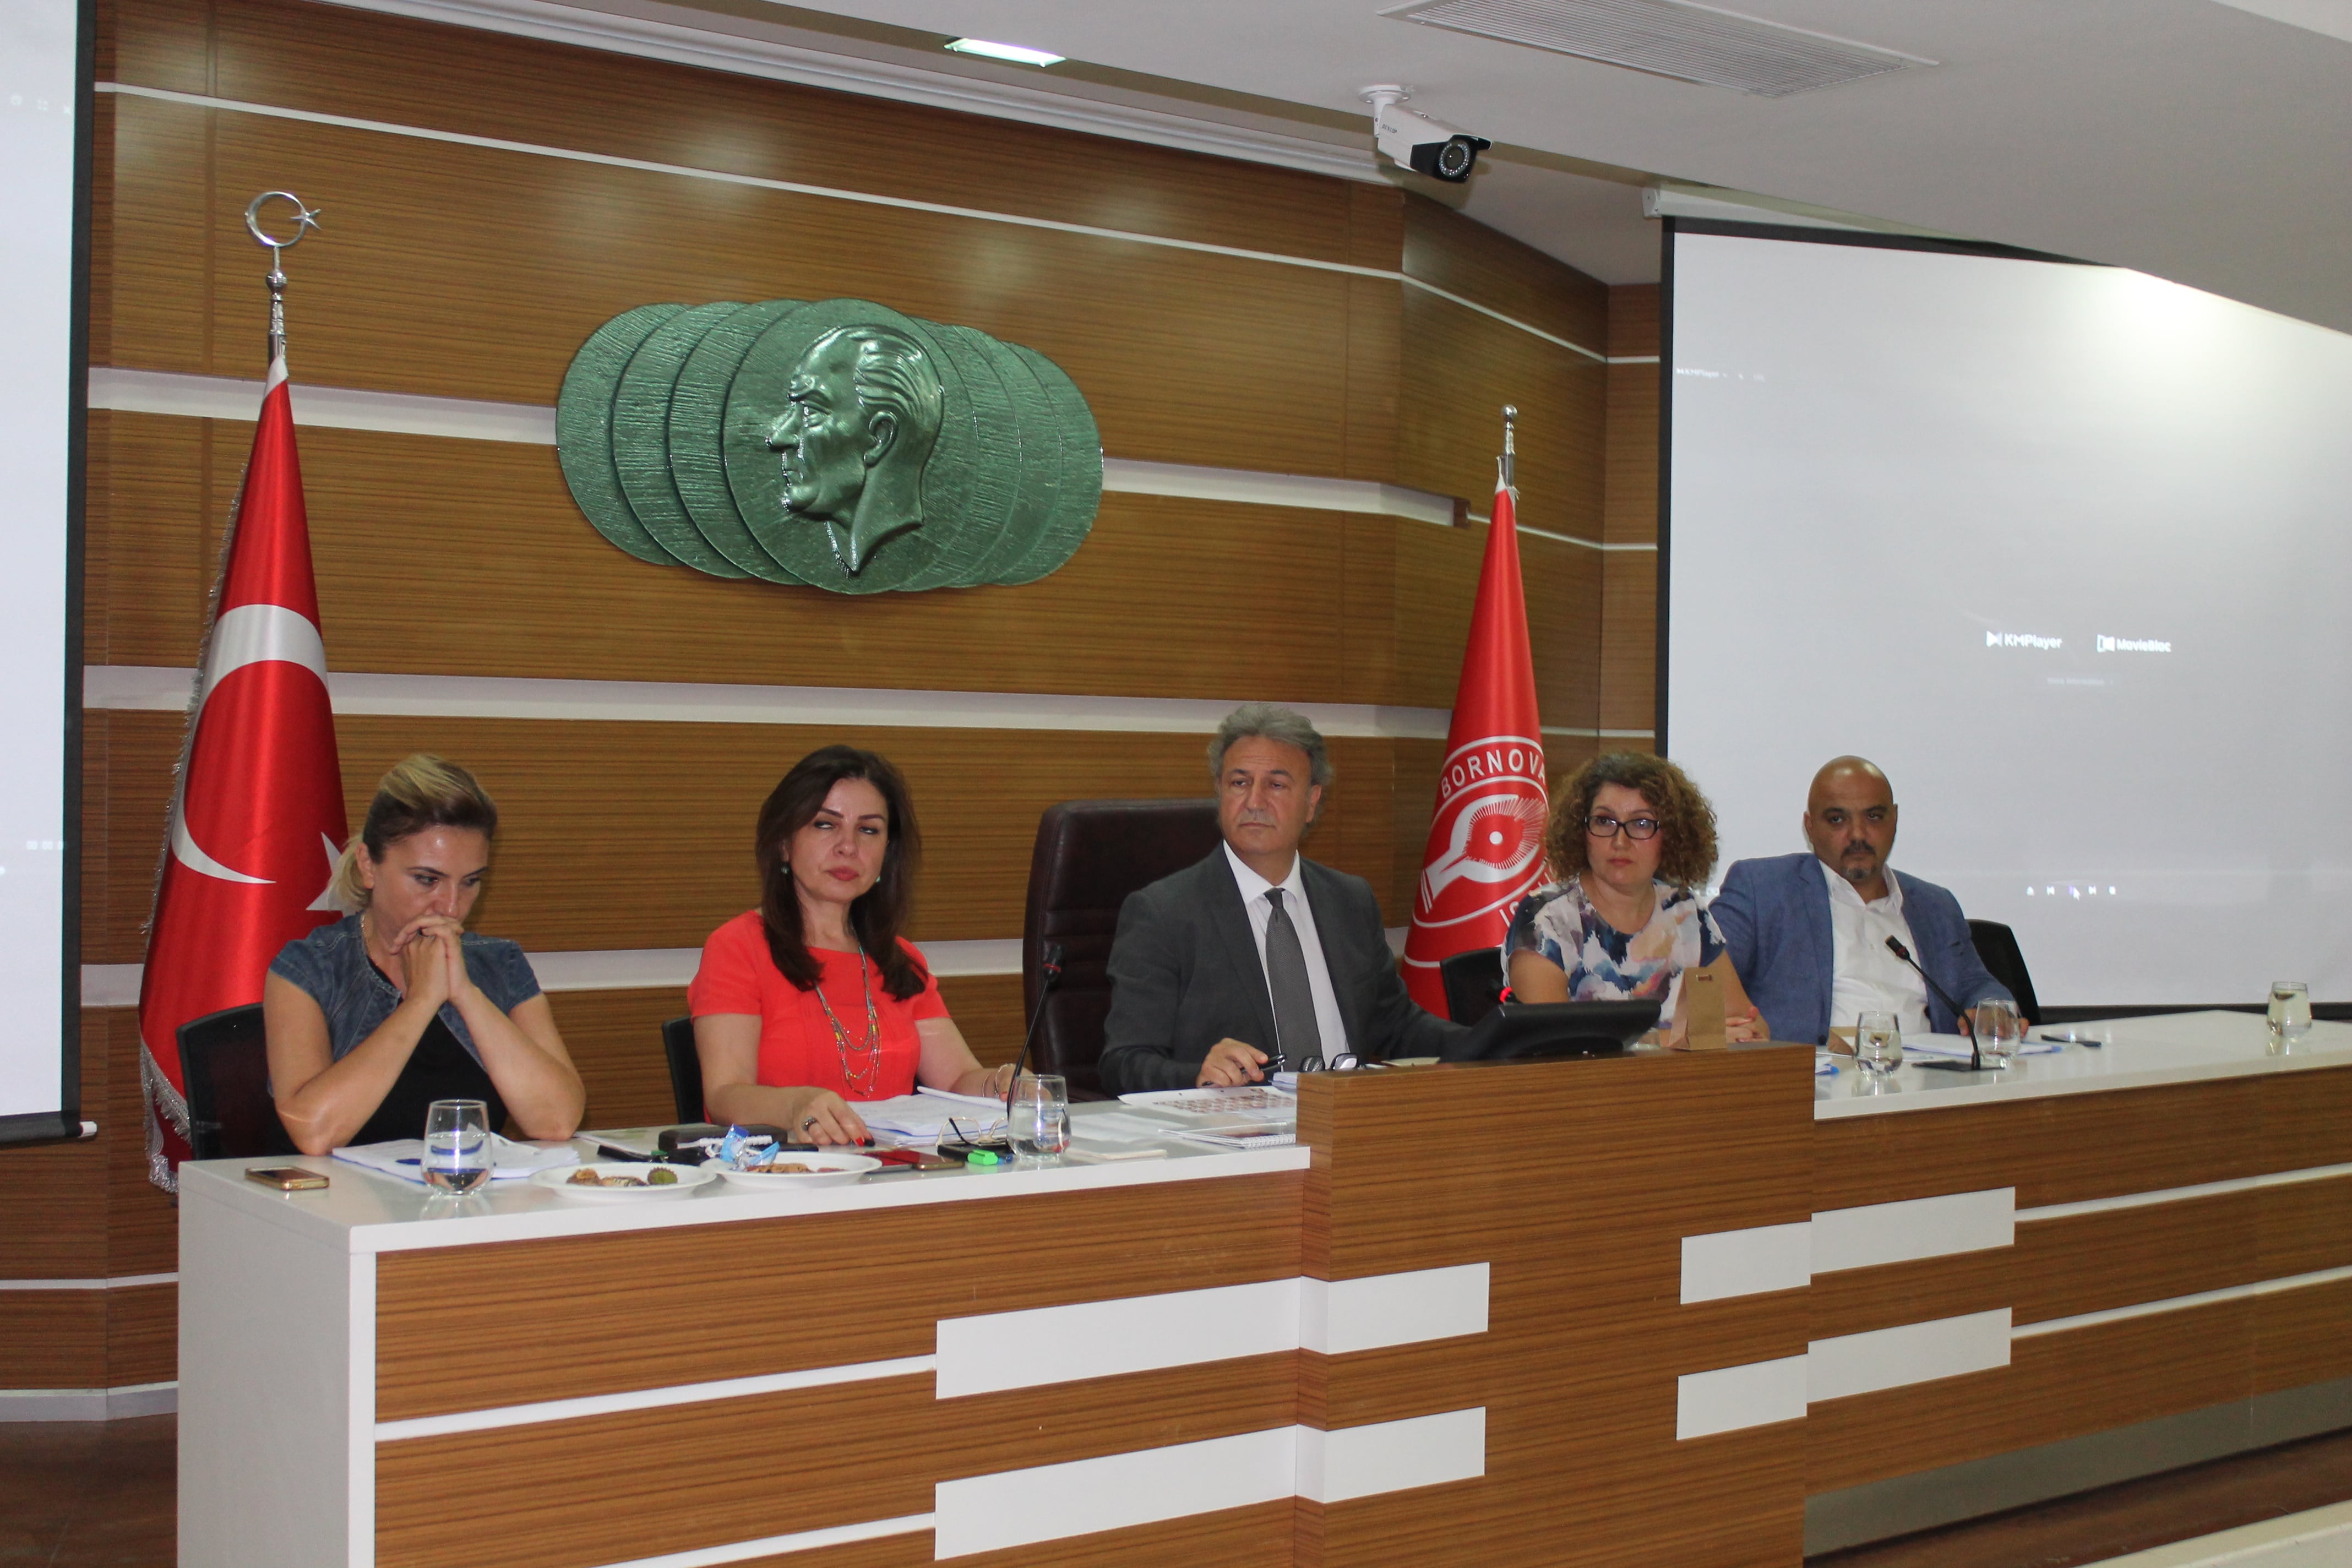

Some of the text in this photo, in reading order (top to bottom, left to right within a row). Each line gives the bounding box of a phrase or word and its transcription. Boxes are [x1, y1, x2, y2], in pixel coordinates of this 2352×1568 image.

[2005, 633, 2062, 650] KMPlayer
[2116, 639, 2171, 652] MovieBloc
[1441, 749, 1545, 798] BORNOVA
